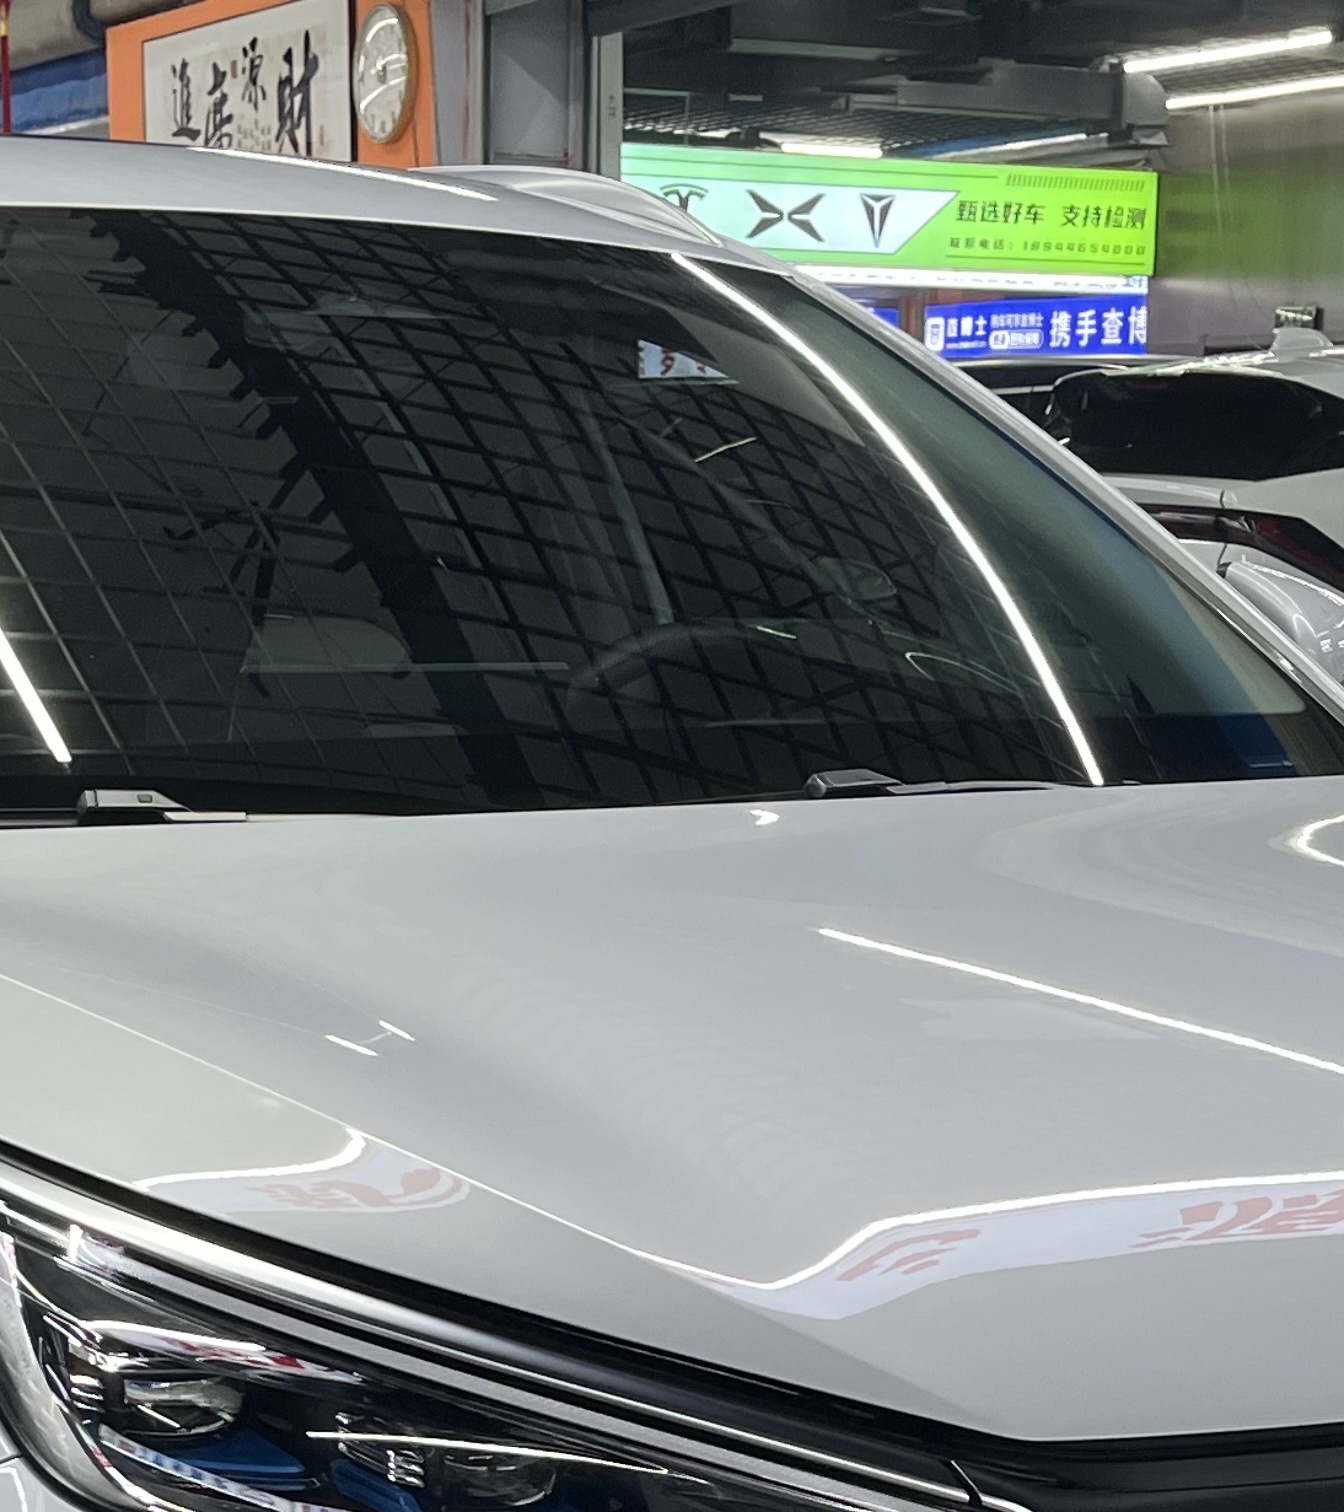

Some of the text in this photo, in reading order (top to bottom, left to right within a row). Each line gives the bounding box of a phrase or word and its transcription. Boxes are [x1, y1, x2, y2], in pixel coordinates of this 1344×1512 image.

[956, 199, 1148, 230] 甄选好车 支持检测
